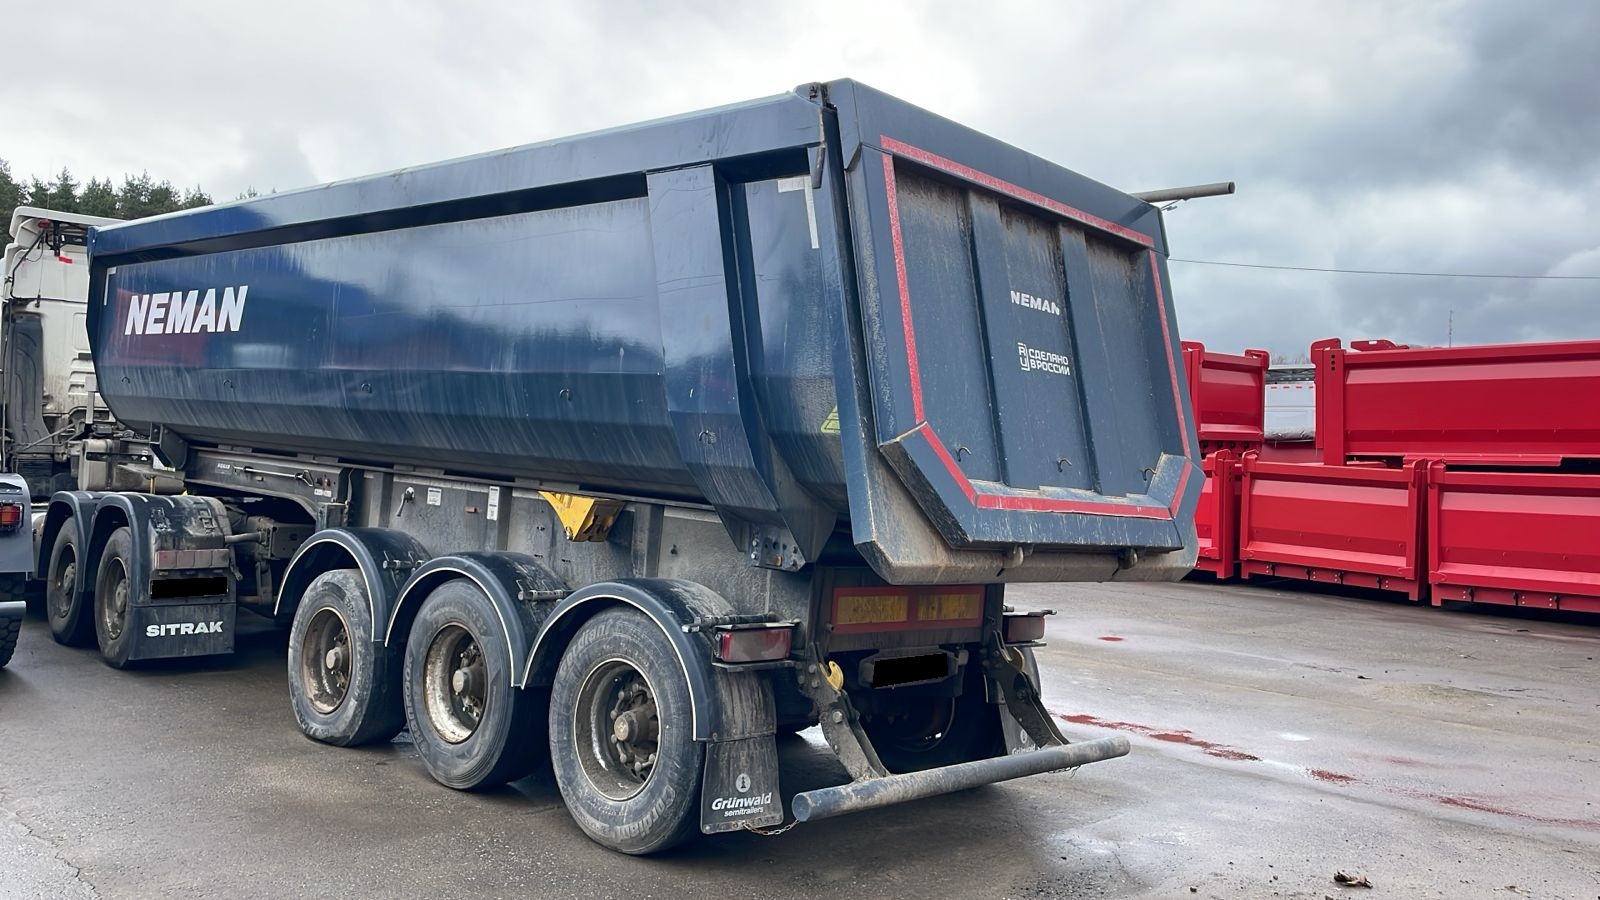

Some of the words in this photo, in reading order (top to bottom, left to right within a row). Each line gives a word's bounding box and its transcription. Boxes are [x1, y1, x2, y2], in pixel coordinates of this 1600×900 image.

[125, 285, 248, 335] NEMAN
[1010, 290, 1060, 316] NEMAN
[1028, 348, 1069, 365] СДЕЛАНО
[146, 620, 224, 637] SITRAK
[711, 792, 772, 810] Grünwald
[724, 806, 764, 817] semitrailers
